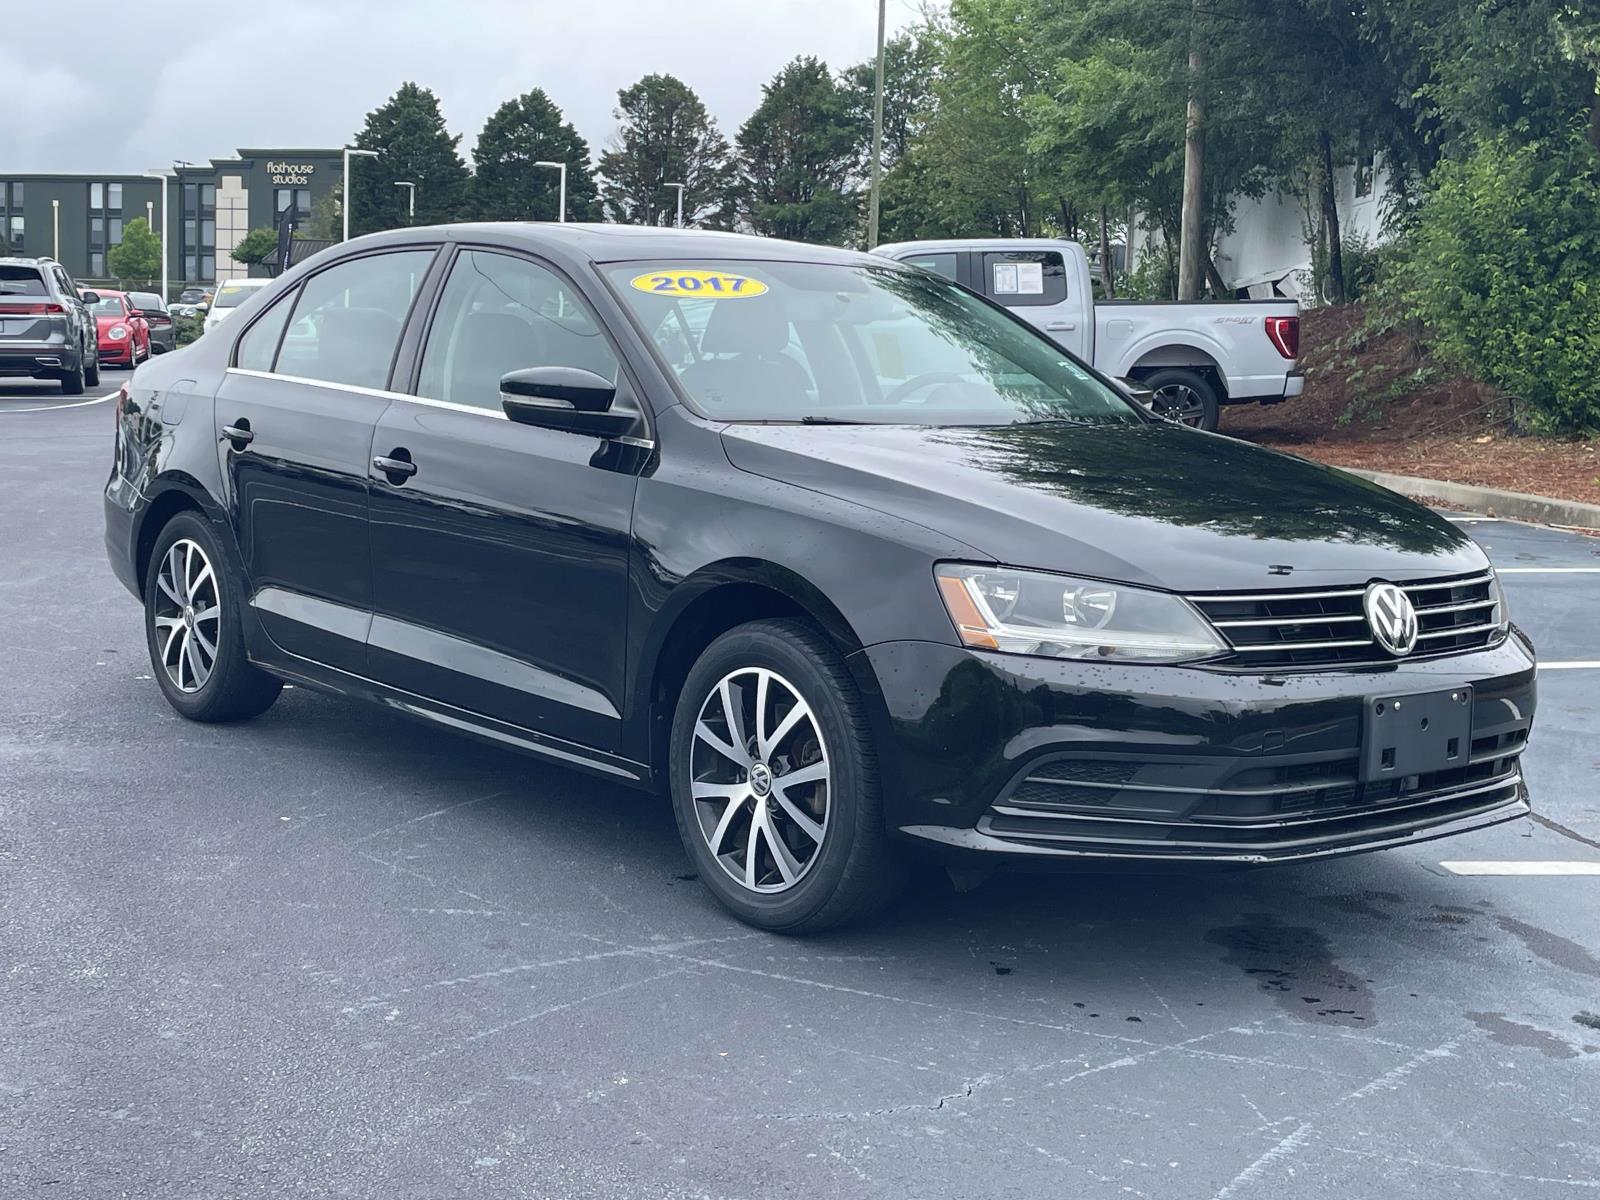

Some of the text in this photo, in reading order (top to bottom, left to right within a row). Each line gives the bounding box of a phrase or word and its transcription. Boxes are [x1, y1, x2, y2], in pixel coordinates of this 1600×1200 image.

[266, 161, 314, 174] flathouse
[272, 173, 308, 185] studios
[650, 276, 748, 292] 2017
